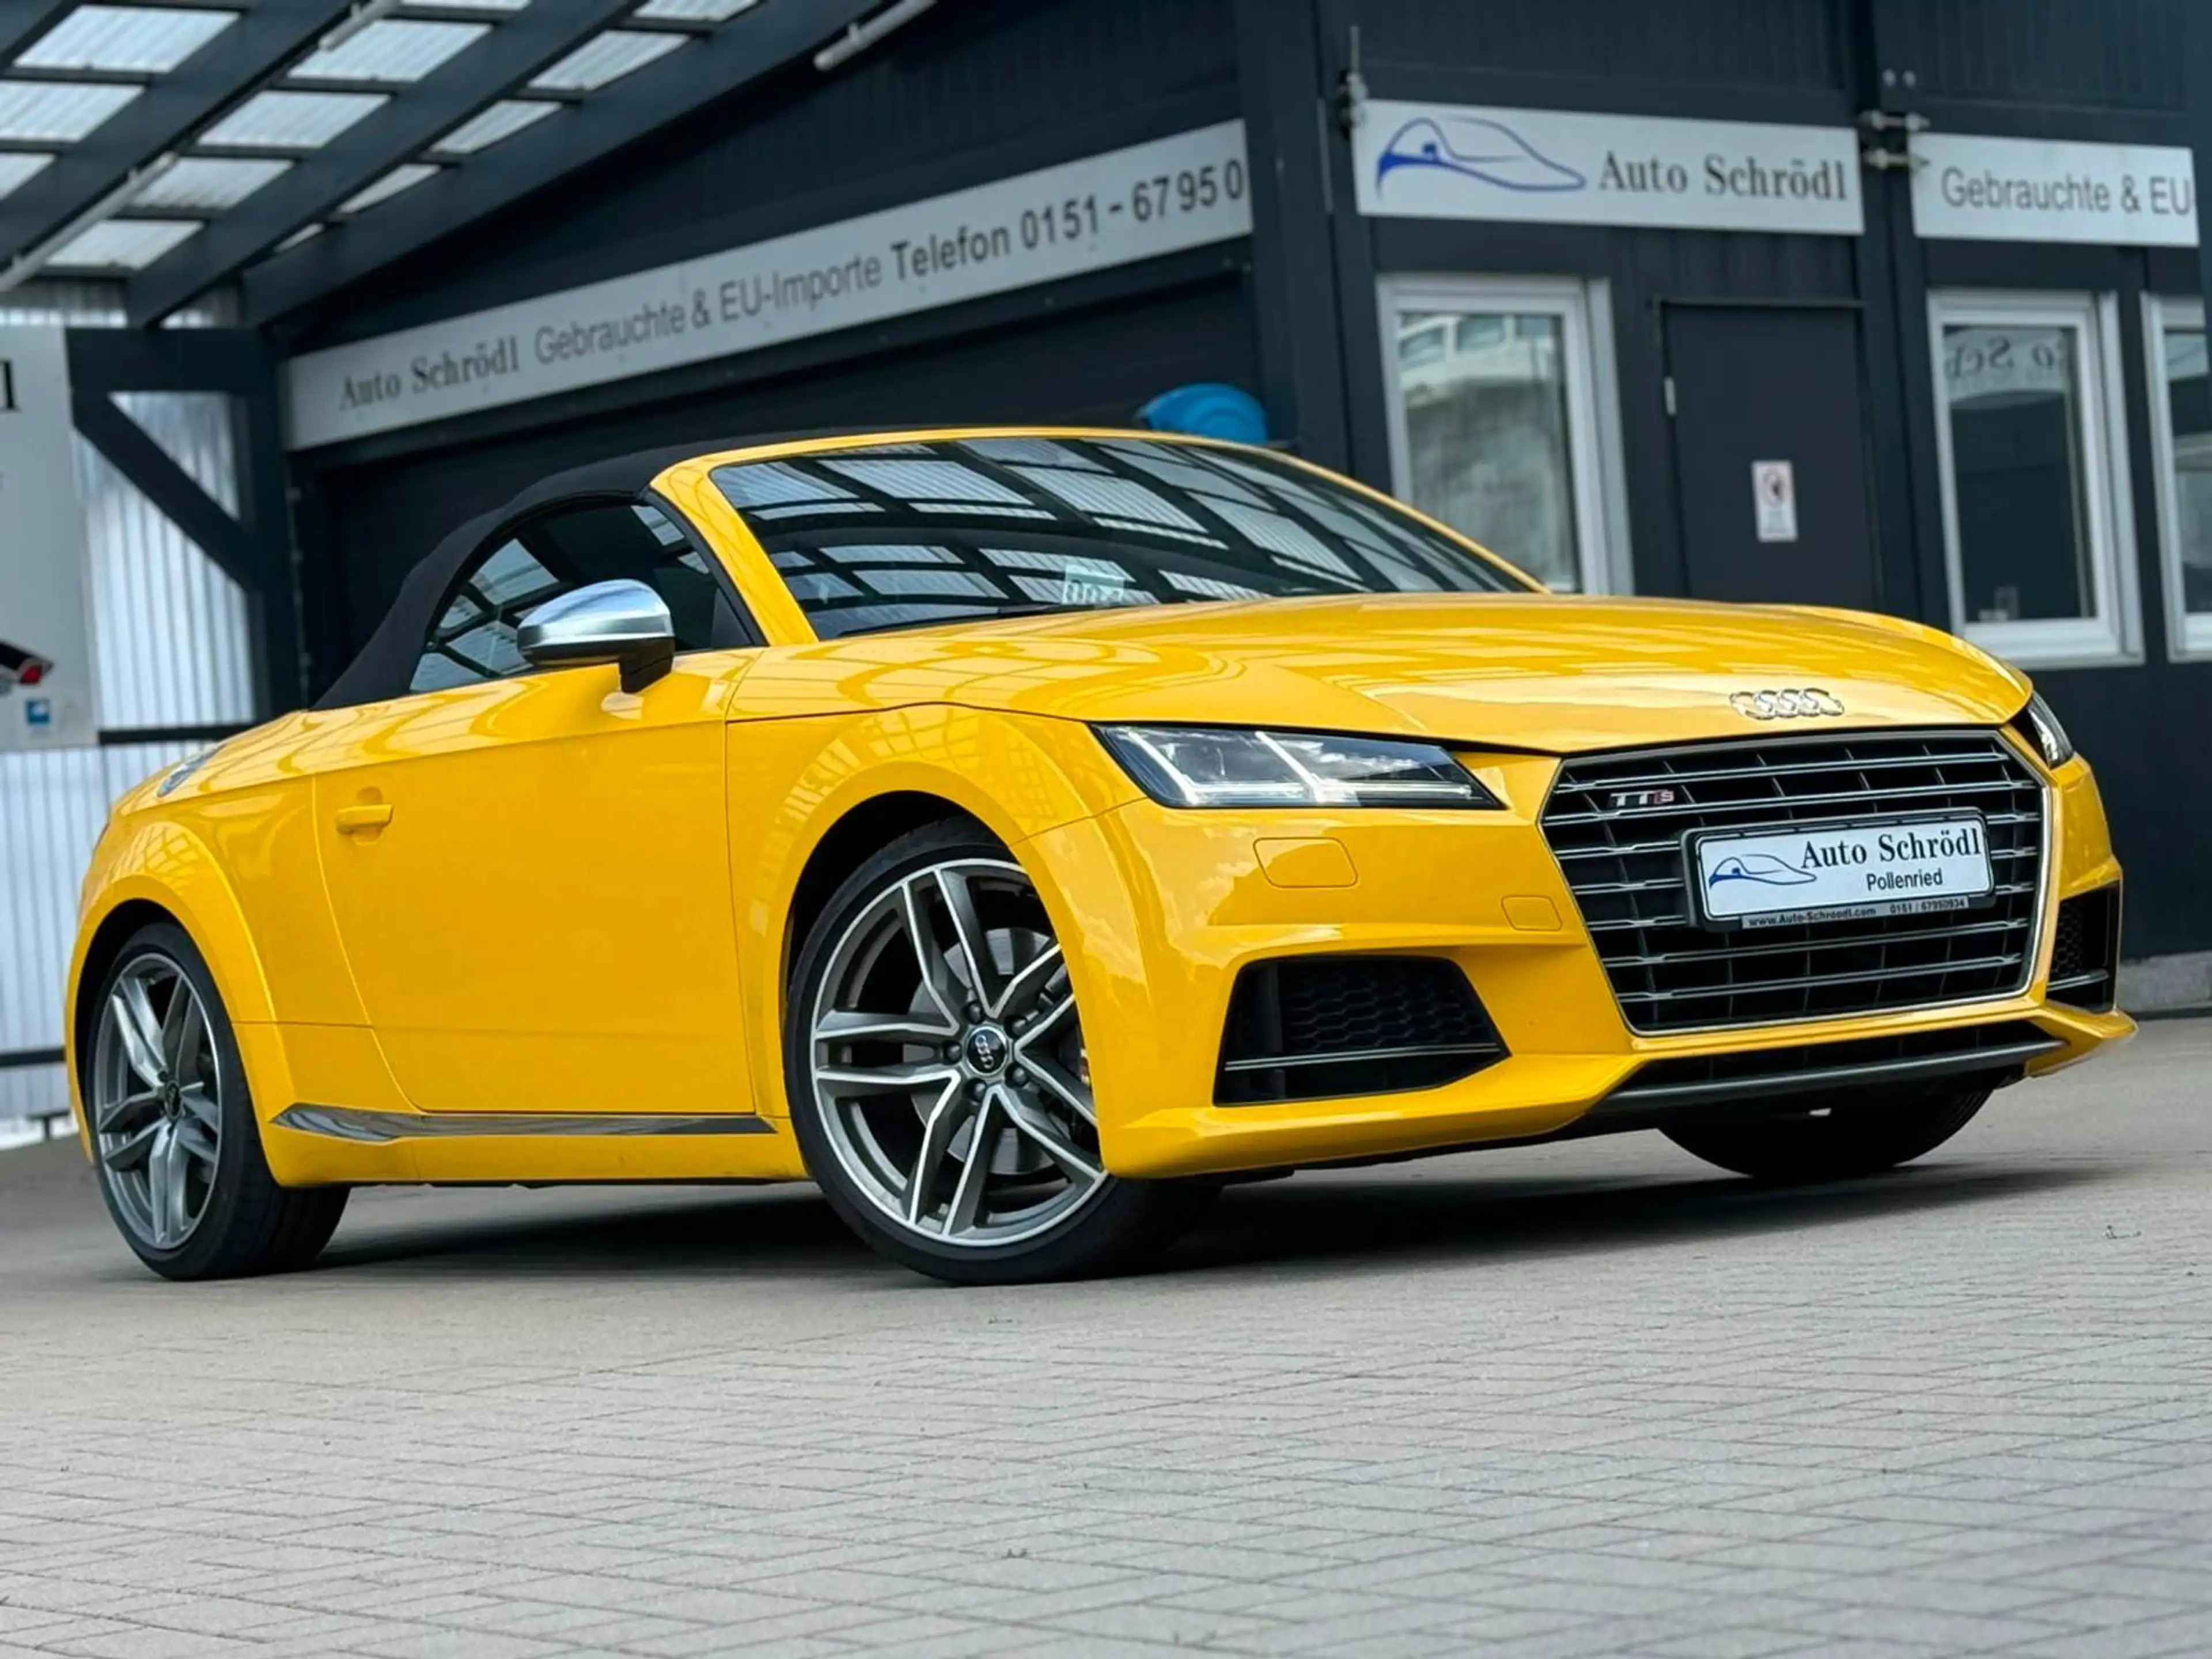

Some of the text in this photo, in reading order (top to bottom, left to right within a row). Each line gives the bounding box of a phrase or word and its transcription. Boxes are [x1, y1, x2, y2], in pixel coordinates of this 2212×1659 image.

[1599, 151, 1848, 200] Auto Schrödl
[1941, 166, 2111, 213] Gebrauchte
[2120, 173, 2142, 215] &
[339, 374, 400, 411] Auto
[411, 336, 519, 393] Schrödl
[535, 304, 685, 365] Gebrauchte
[692, 289, 711, 329] &
[719, 254, 882, 321] EU-Importe
[891, 225, 1010, 281] Telefon
[1021, 195, 1098, 251] 0151
[1611, 789, 1675, 806] TTS
[1800, 828, 1980, 869] Auto Schrödl
[1866, 869, 1943, 891] Pollenried
